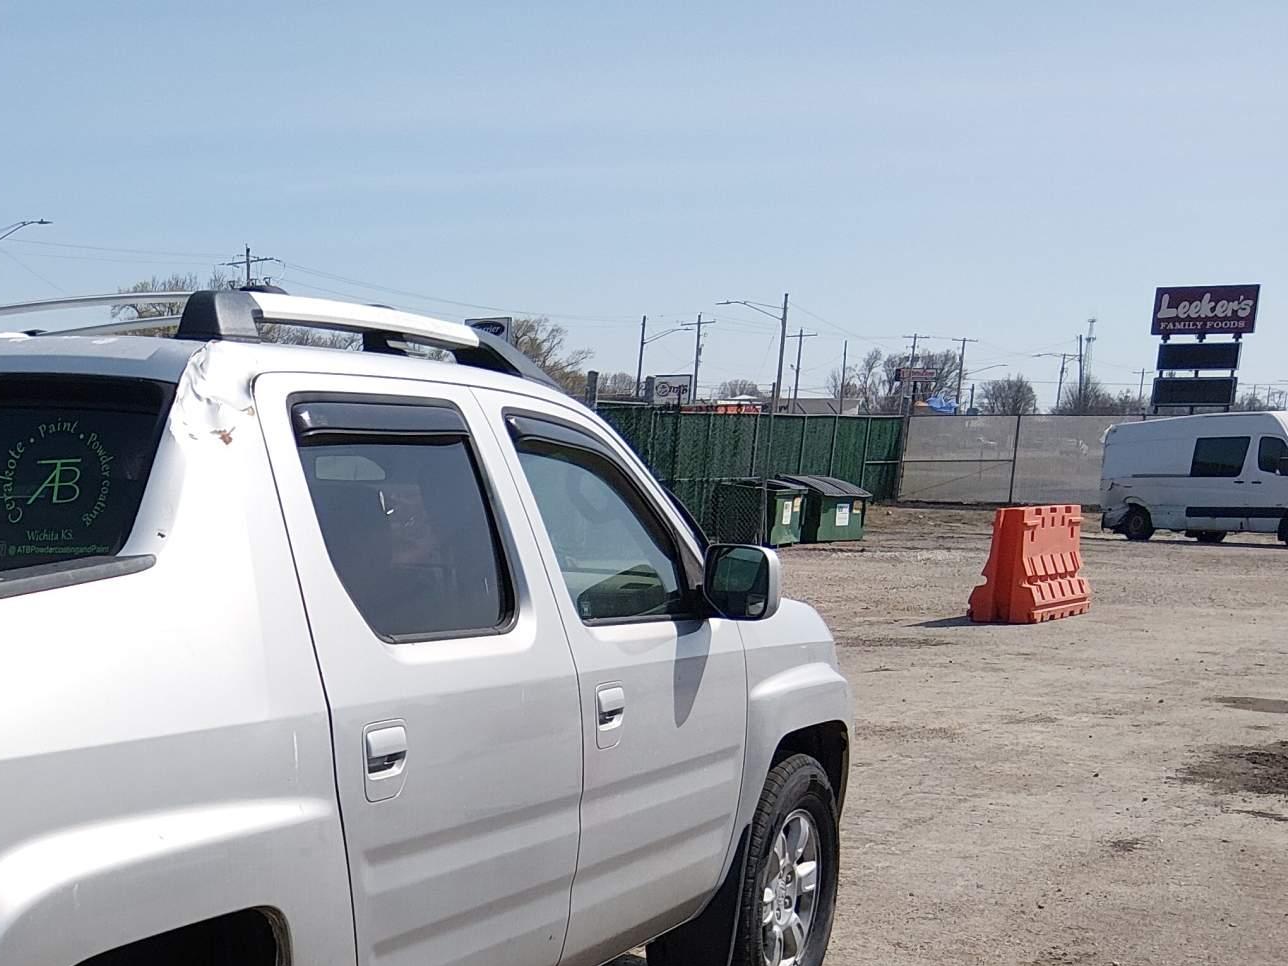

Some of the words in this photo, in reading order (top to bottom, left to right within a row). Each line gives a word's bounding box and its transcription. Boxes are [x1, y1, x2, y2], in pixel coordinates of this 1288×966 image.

[1157, 293, 1254, 318] Leeker's
[1159, 321, 1204, 330] FAMILY
[1206, 320, 1246, 329] FOODS
[87, 432, 114, 477] Powder
[26, 528, 59, 542] Wichita
